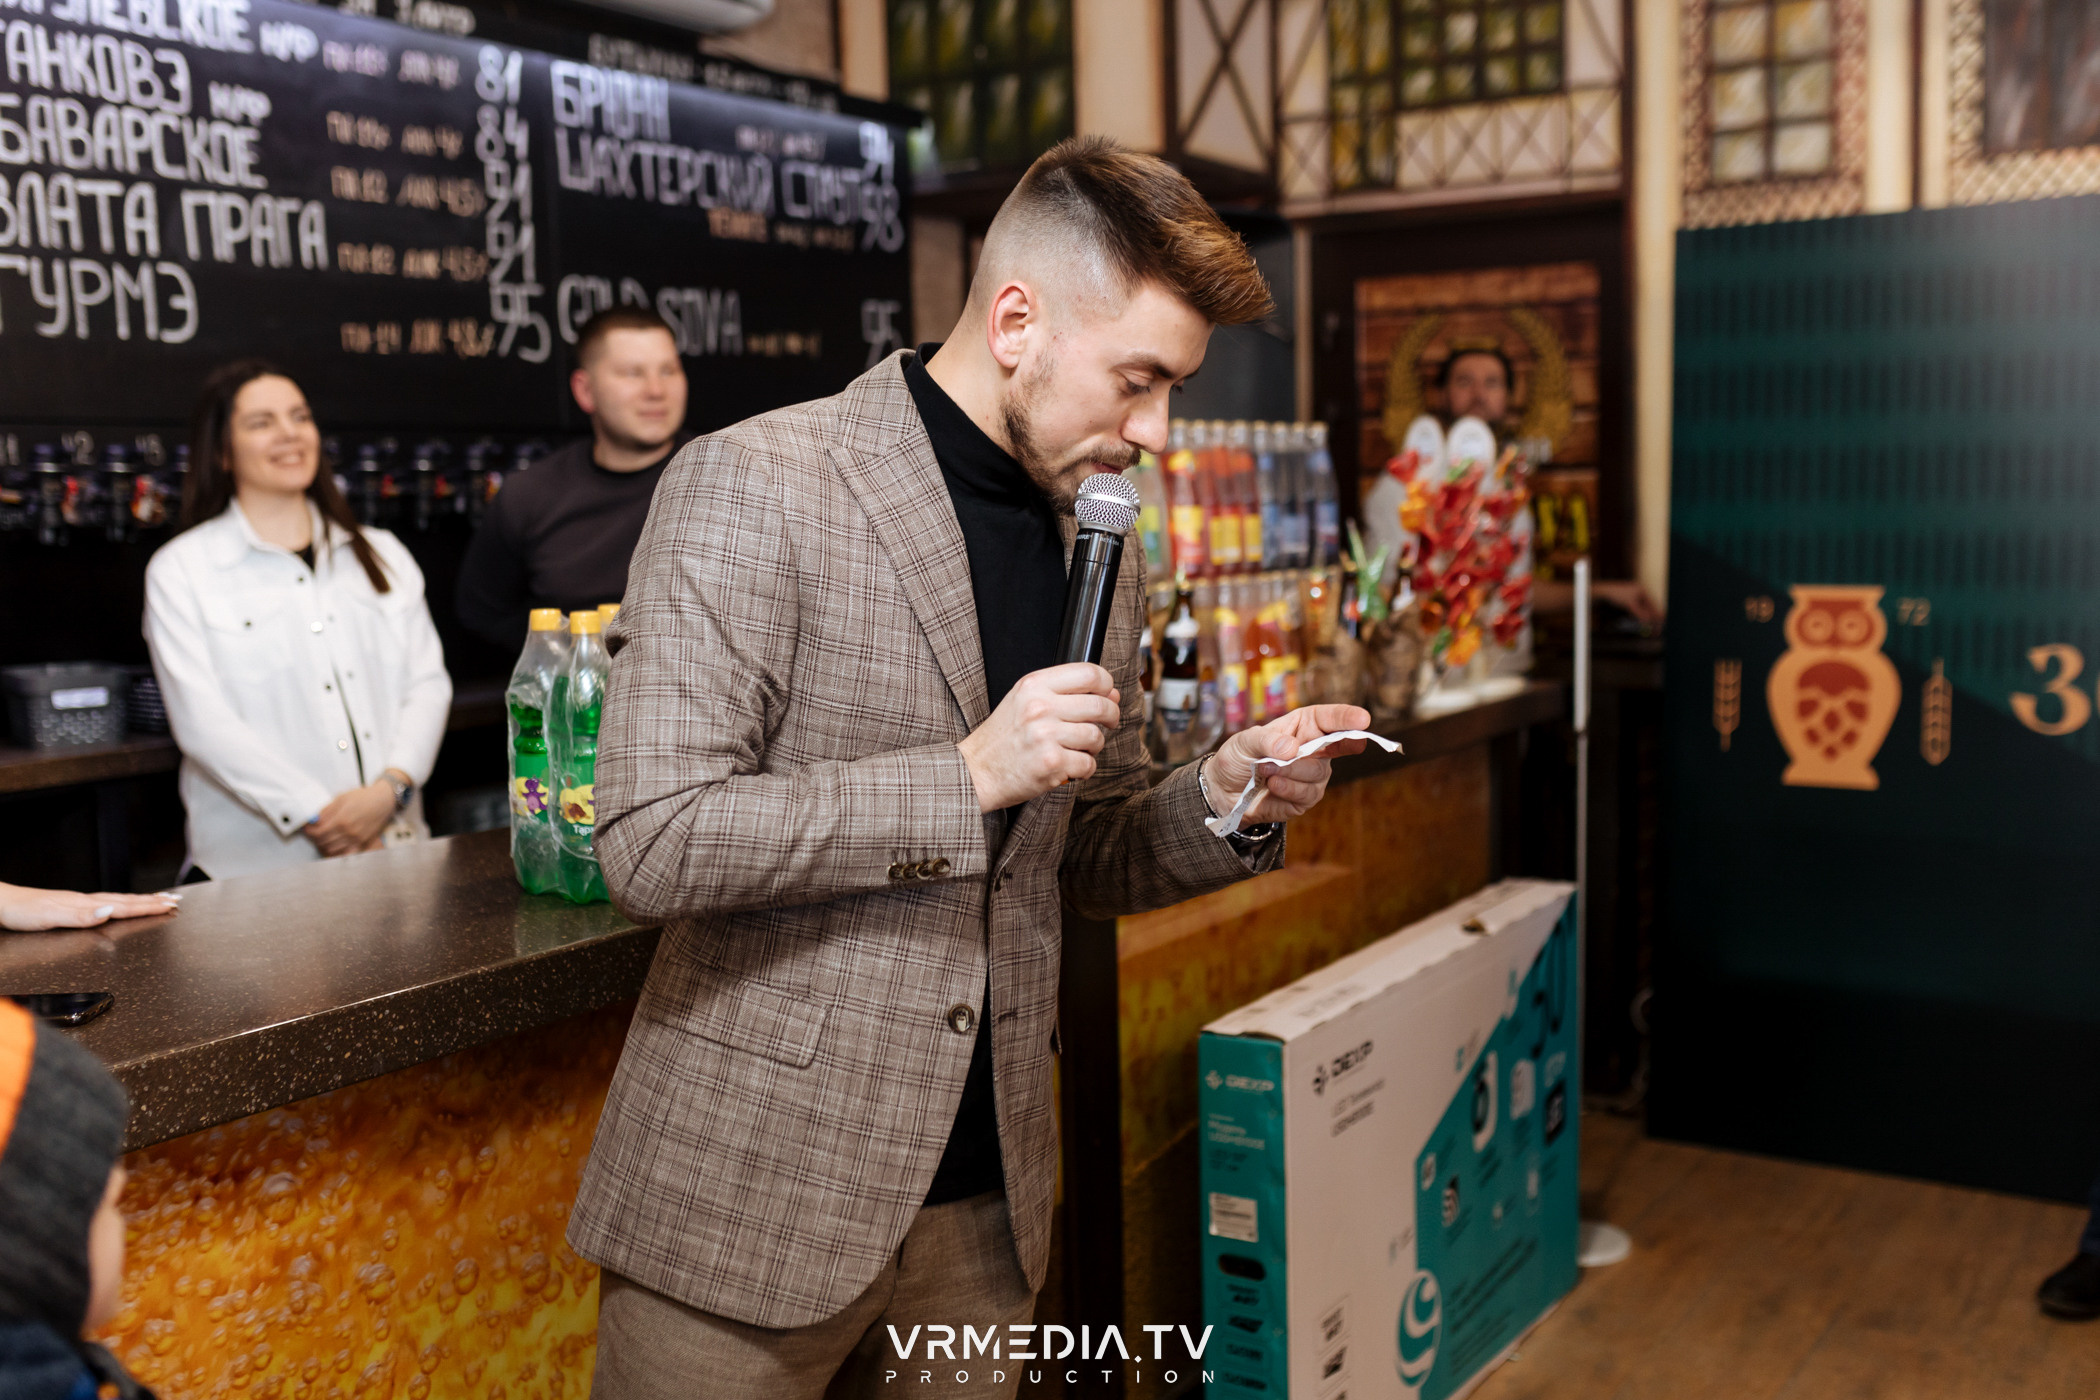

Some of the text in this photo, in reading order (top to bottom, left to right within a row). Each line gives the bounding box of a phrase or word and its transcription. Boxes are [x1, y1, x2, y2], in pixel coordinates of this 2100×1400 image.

[0, 17, 193, 116] АНКОВЭ
[474, 43, 524, 105] 81
[180, 188, 329, 270] ПРАГА
